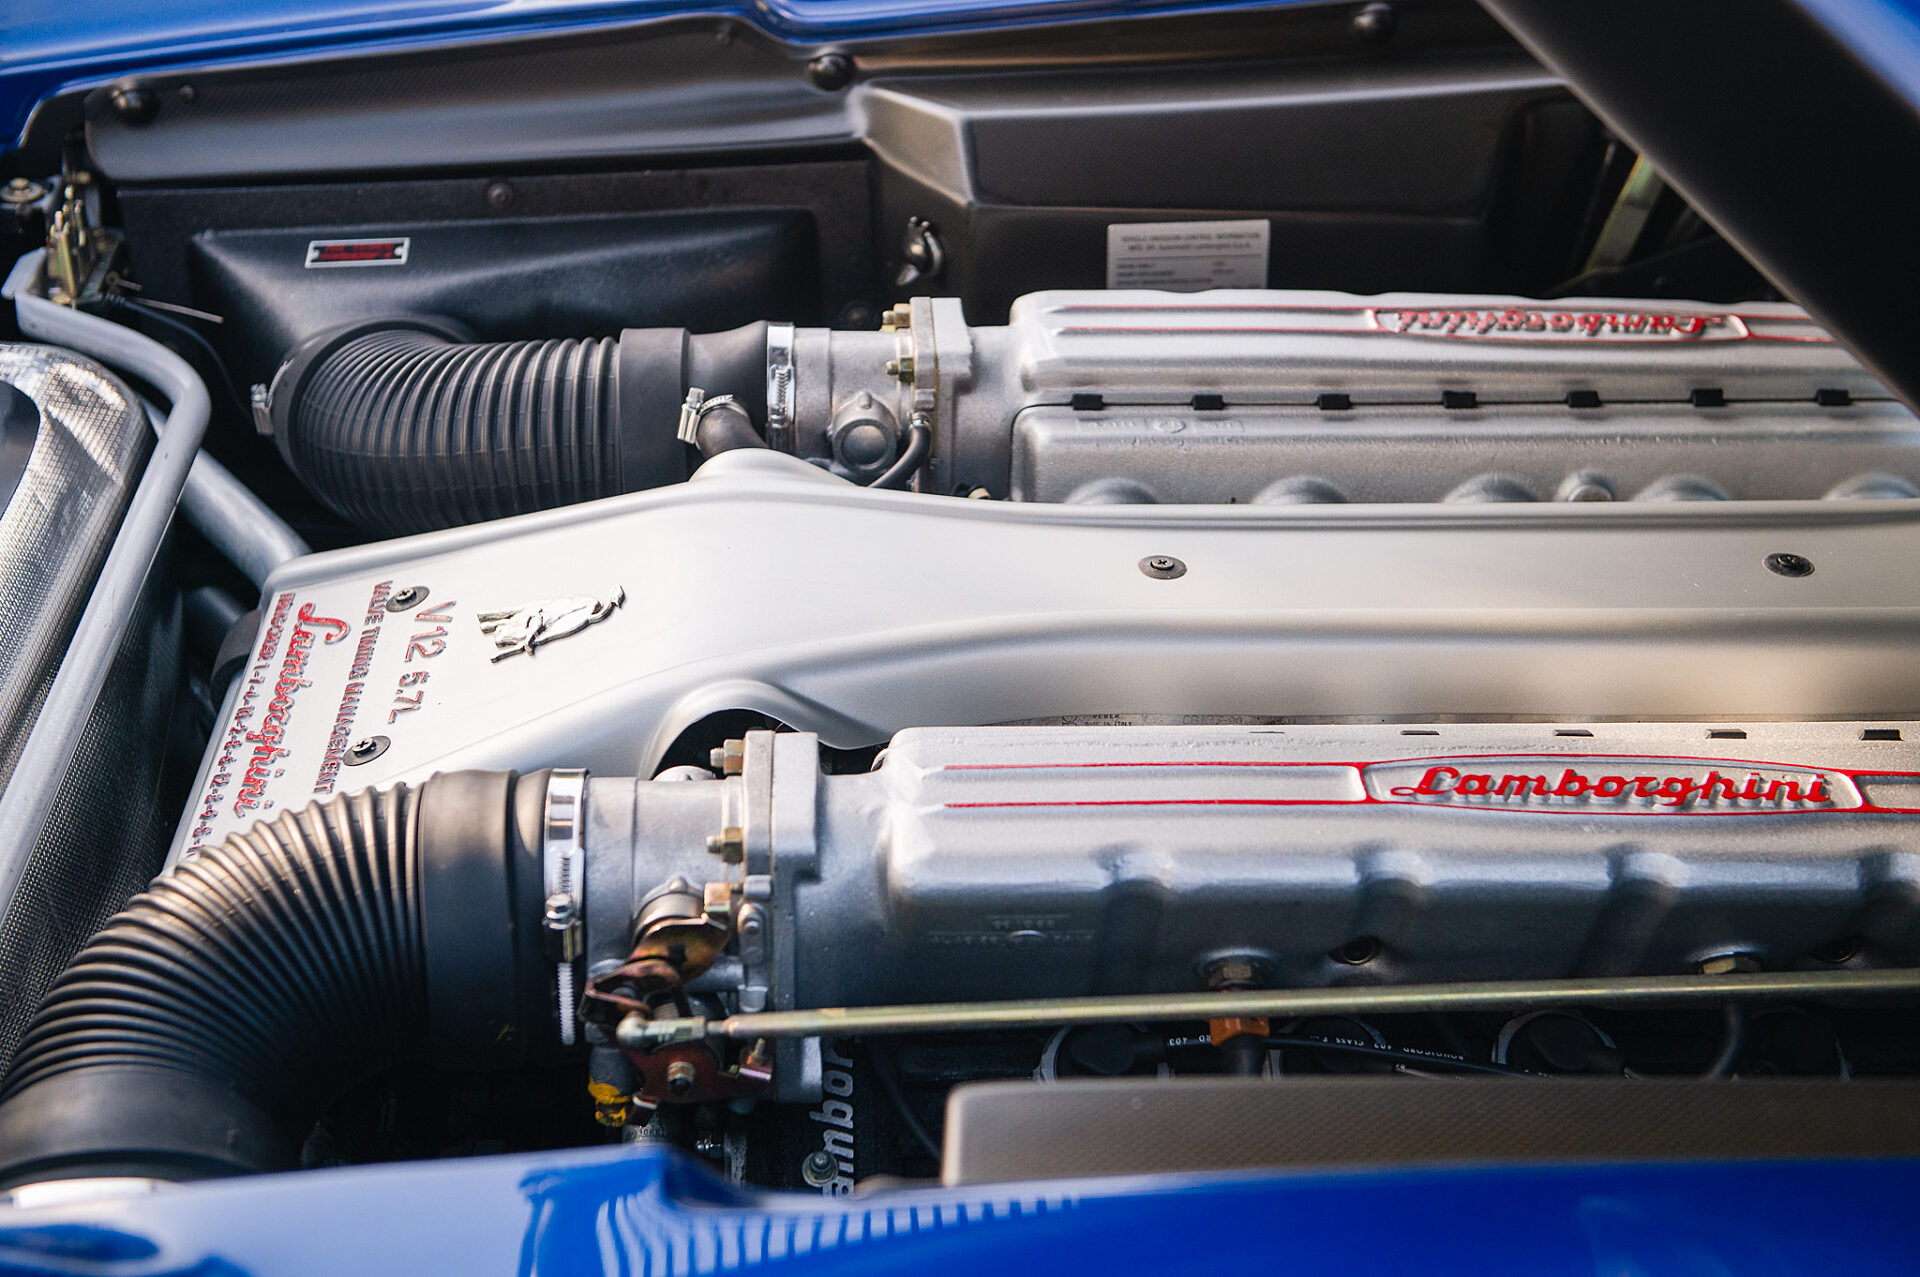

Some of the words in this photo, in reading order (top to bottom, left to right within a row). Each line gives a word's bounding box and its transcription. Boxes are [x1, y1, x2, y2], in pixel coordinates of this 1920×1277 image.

[1395, 308, 1724, 337] Lamborghini
[364, 580, 394, 625] VALVE
[348, 625, 381, 681] TIMING
[233, 602, 352, 819] Lamborghini
[387, 671, 430, 725] 5.7L
[313, 682, 365, 795] MANAGEMENT
[1389, 766, 1833, 810] Lamborghini
